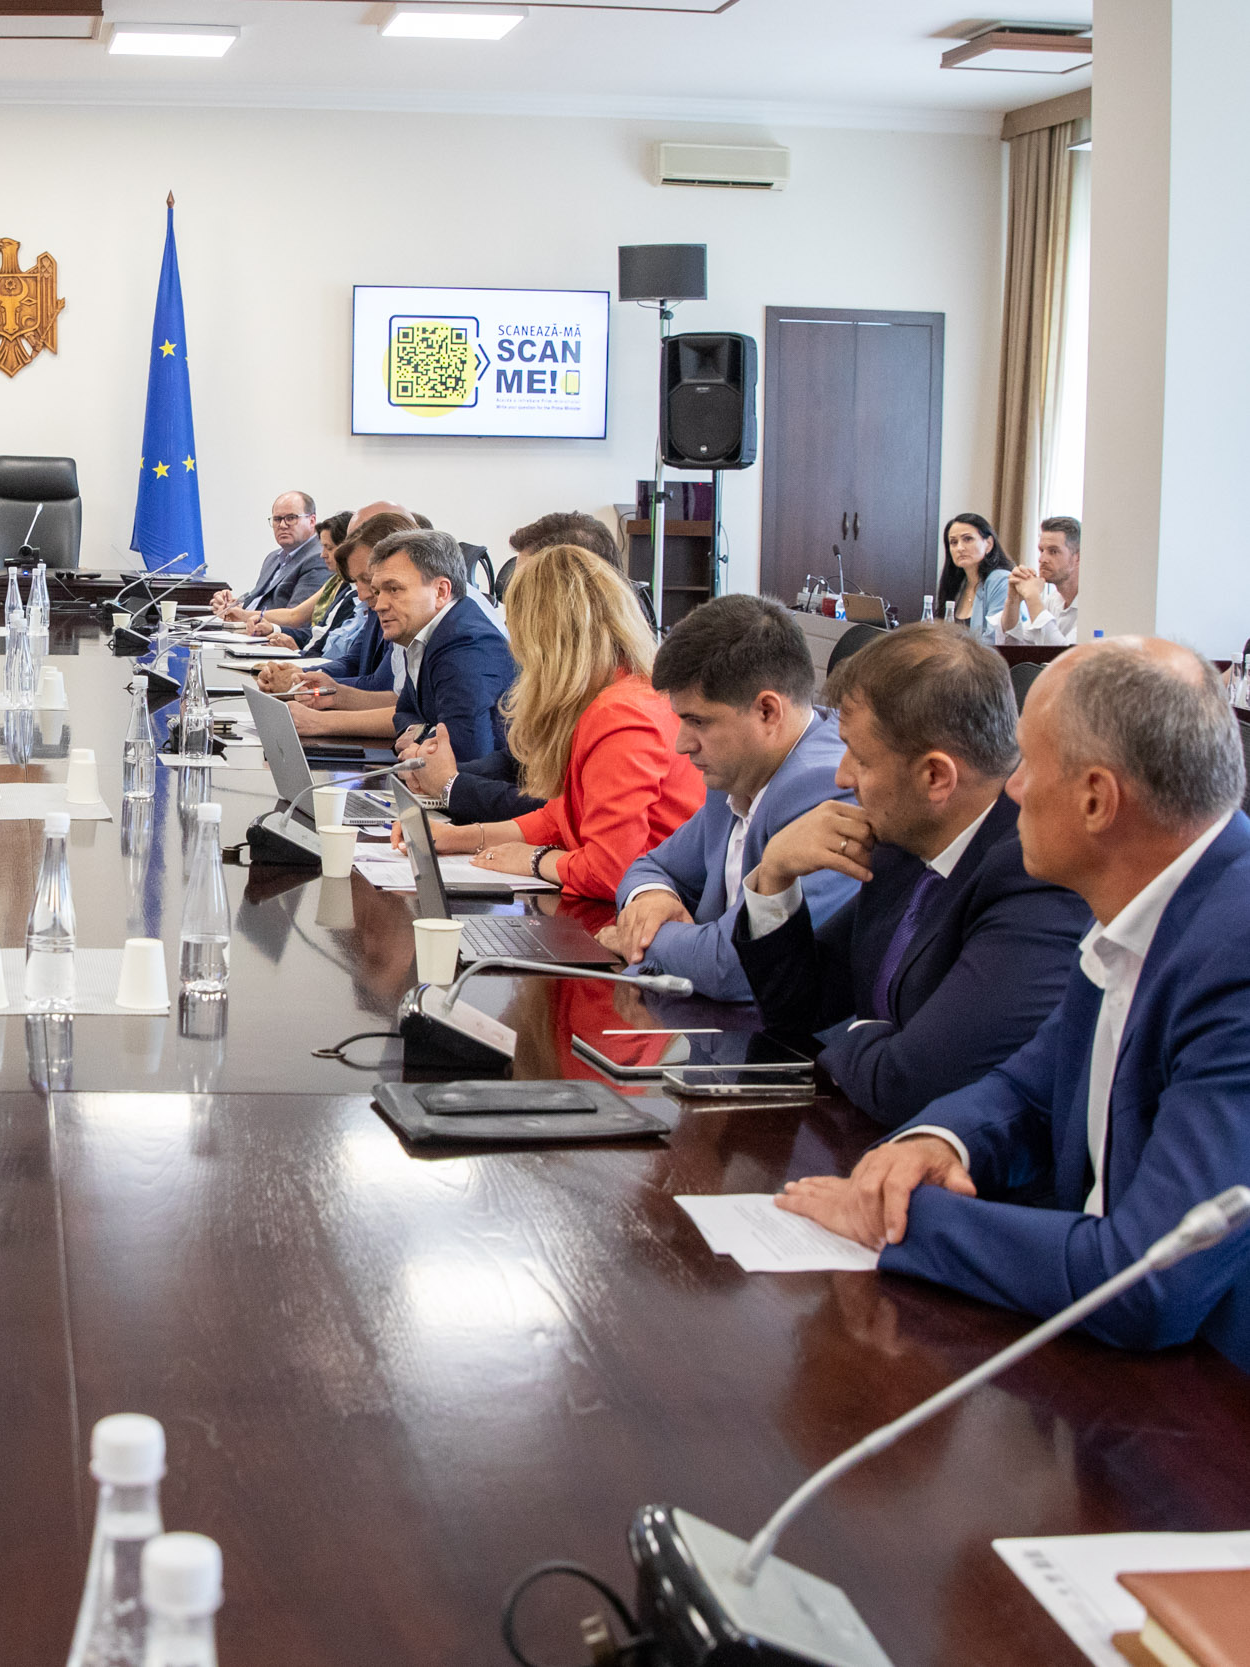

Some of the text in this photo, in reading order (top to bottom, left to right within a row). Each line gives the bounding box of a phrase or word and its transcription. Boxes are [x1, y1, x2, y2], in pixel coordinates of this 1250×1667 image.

[498, 323, 581, 337] SCANEAZĂ-MĂ
[497, 338, 581, 363] SCAN
[496, 369, 557, 394] ME!
